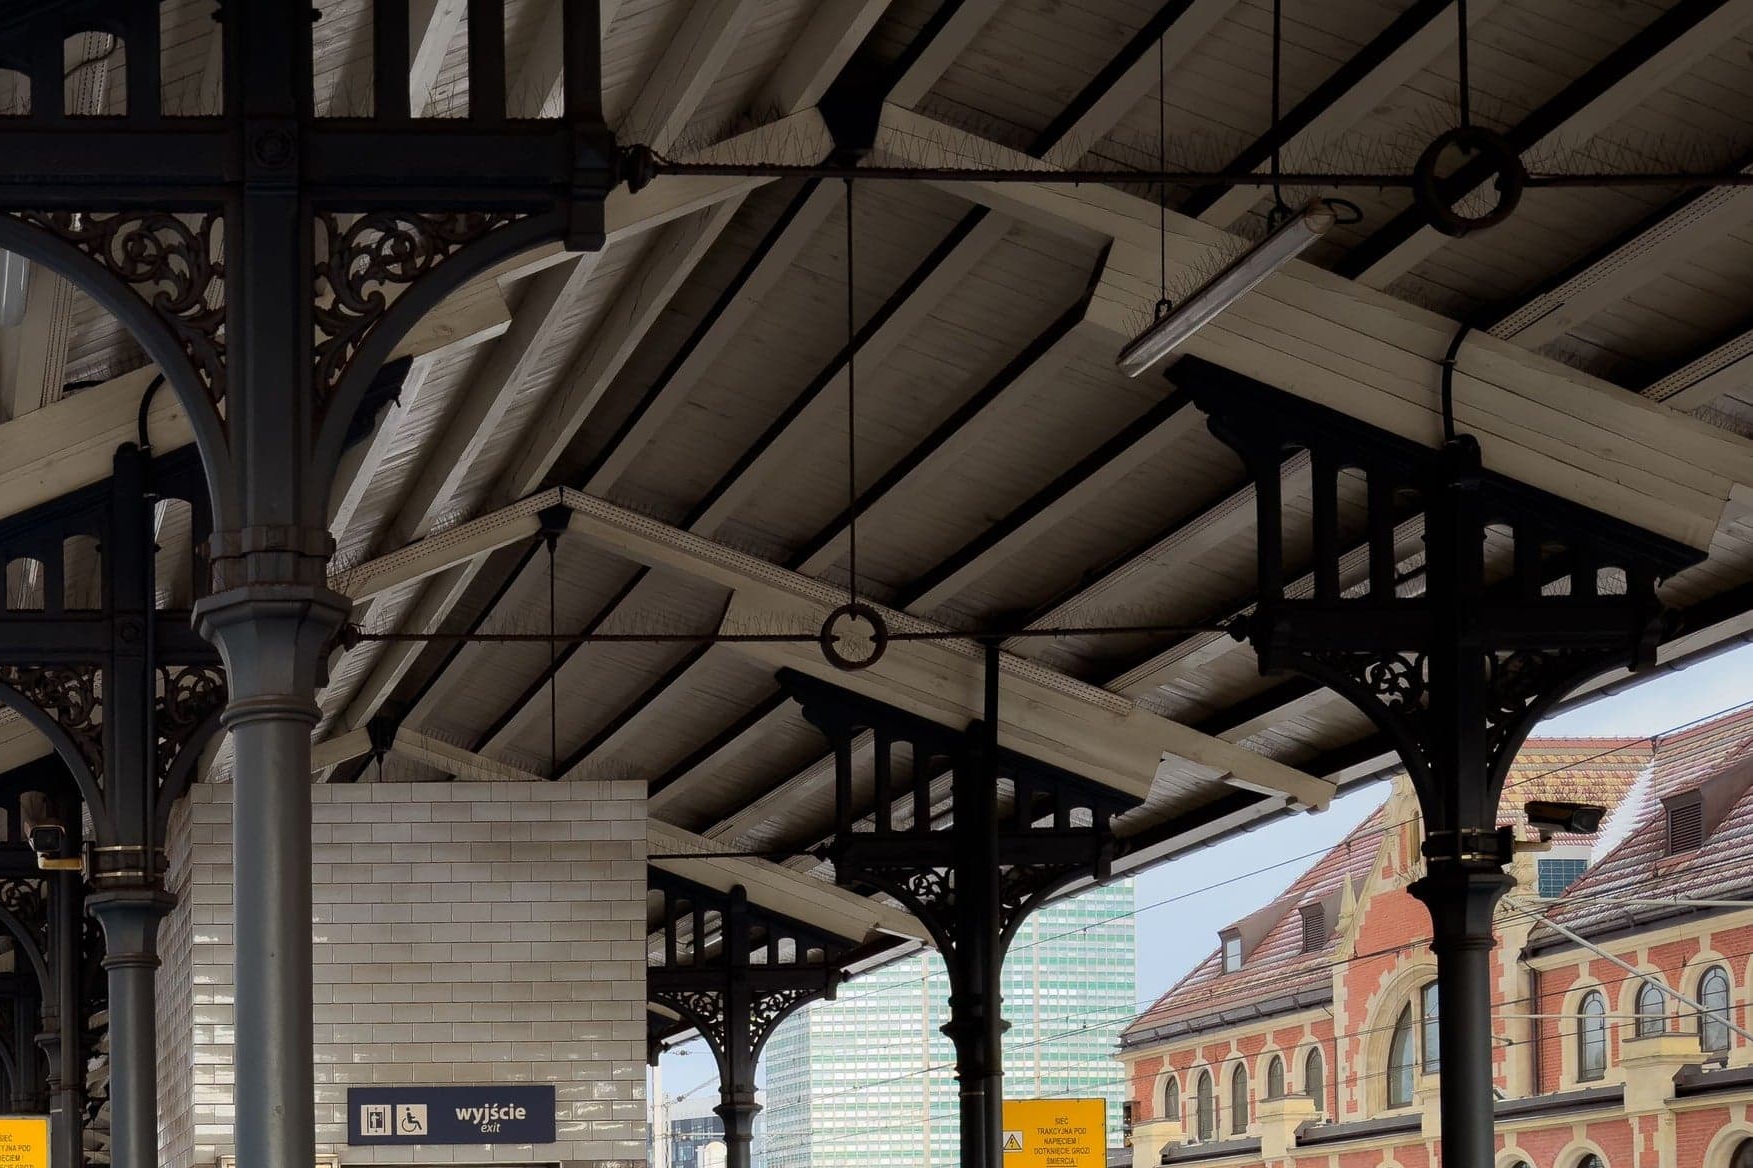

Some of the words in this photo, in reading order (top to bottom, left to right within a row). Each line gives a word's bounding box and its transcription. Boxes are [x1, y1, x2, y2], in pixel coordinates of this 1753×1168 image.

[455, 1103, 527, 1125] wyjście
[480, 1122, 501, 1133] exit
[1037, 1127, 1073, 1135] TRAKCYJNA
[1074, 1127, 1087, 1135] POD
[18, 1144, 31, 1152] POD
[1071, 1147, 1090, 1155] GROZI
